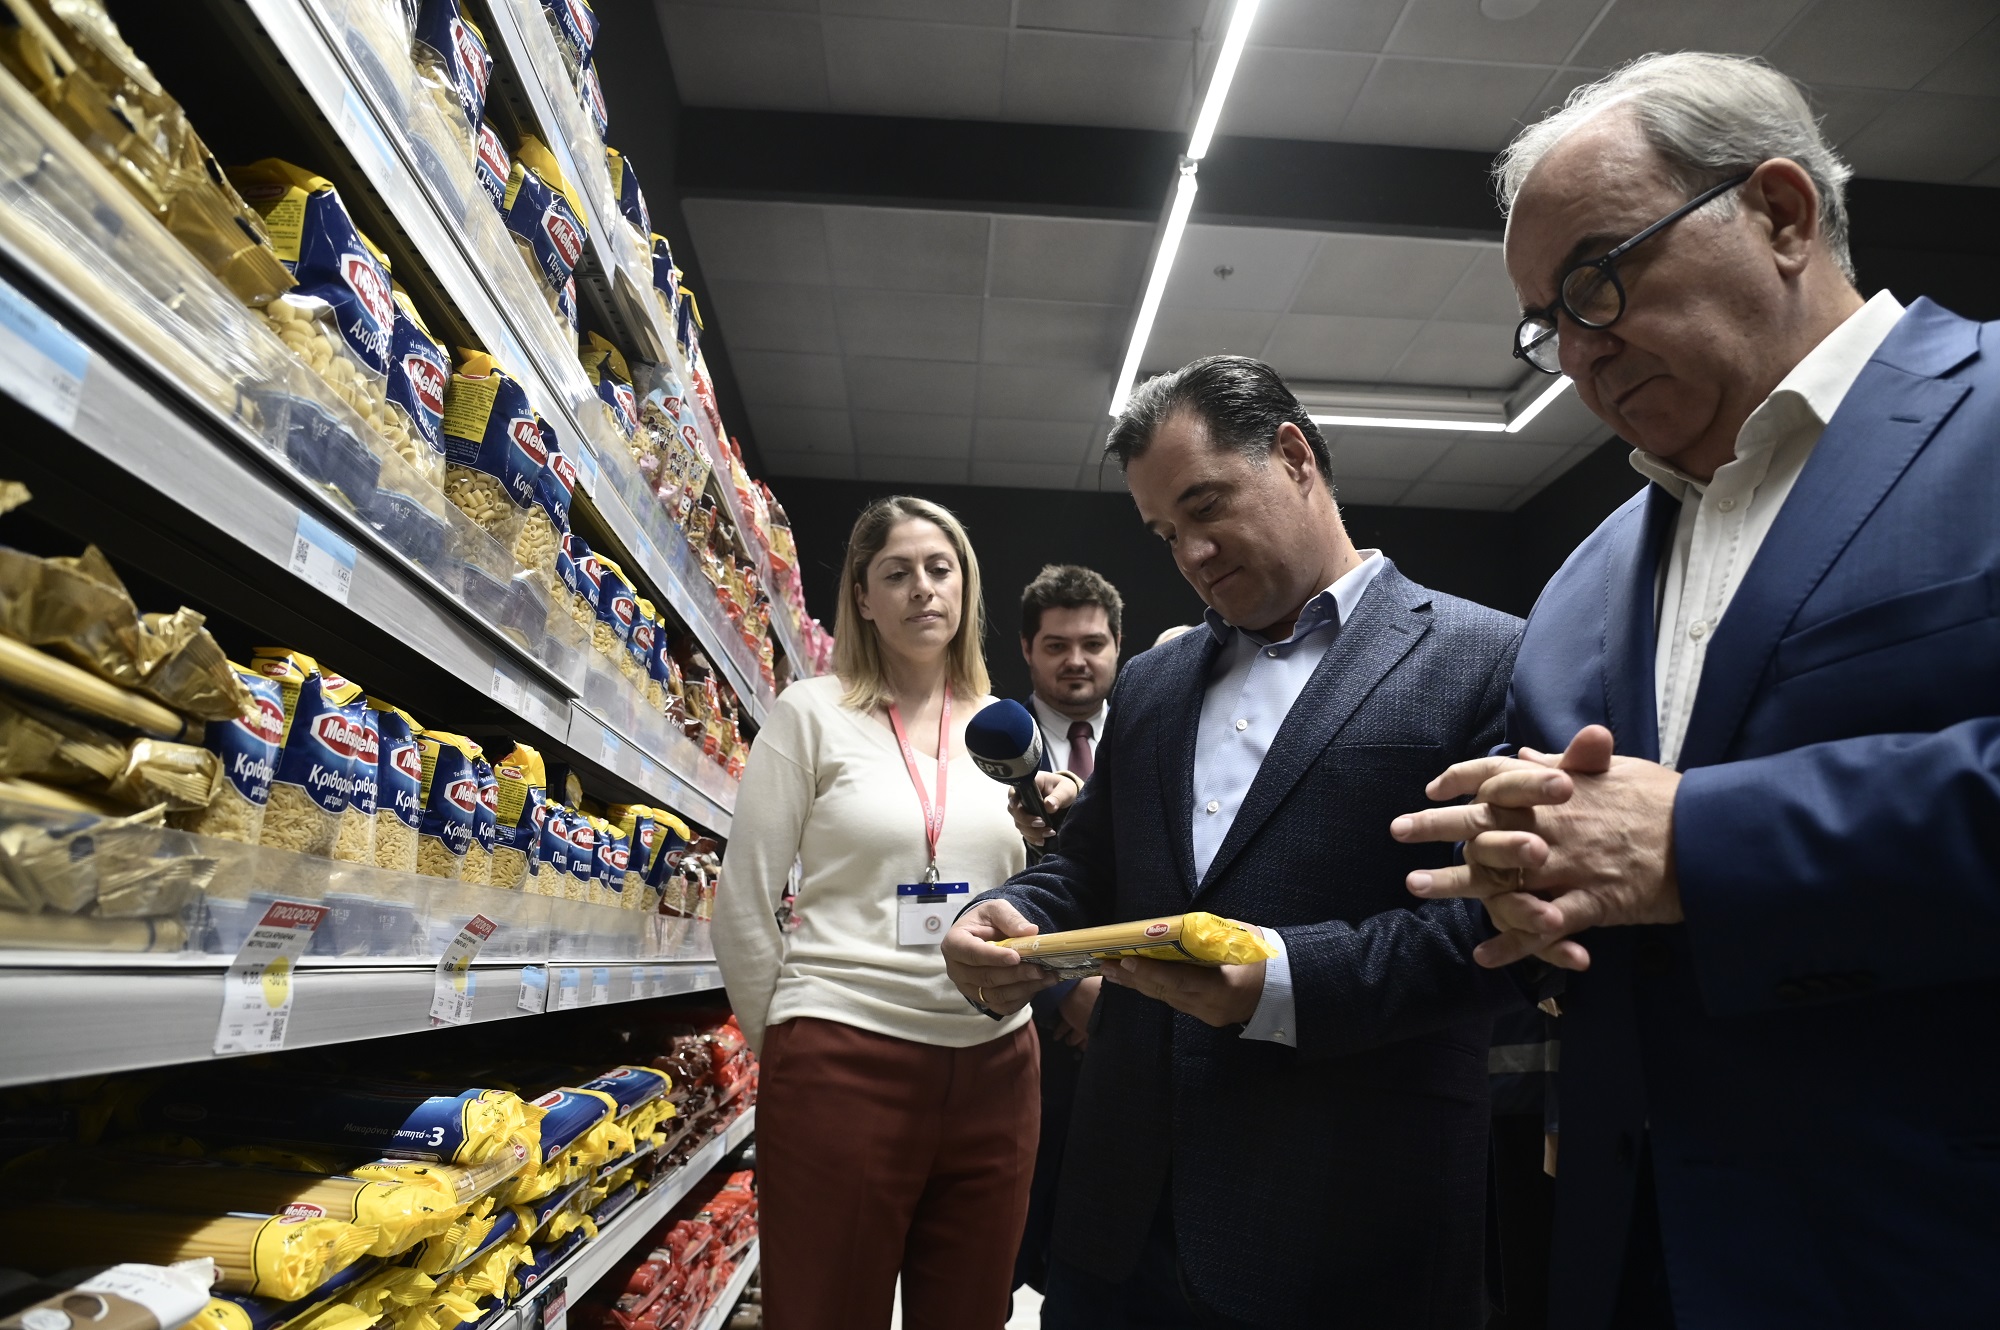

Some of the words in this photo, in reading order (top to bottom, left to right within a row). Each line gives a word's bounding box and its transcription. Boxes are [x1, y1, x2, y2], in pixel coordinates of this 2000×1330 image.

[550, 219, 580, 266] Melissa
[546, 252, 566, 286] Πέννες
[270, 905, 320, 922] ΠΡΟΣΦΟΡΑ
[391, 1130, 427, 1141] τρυπητά
[427, 1126, 445, 1147] 3
